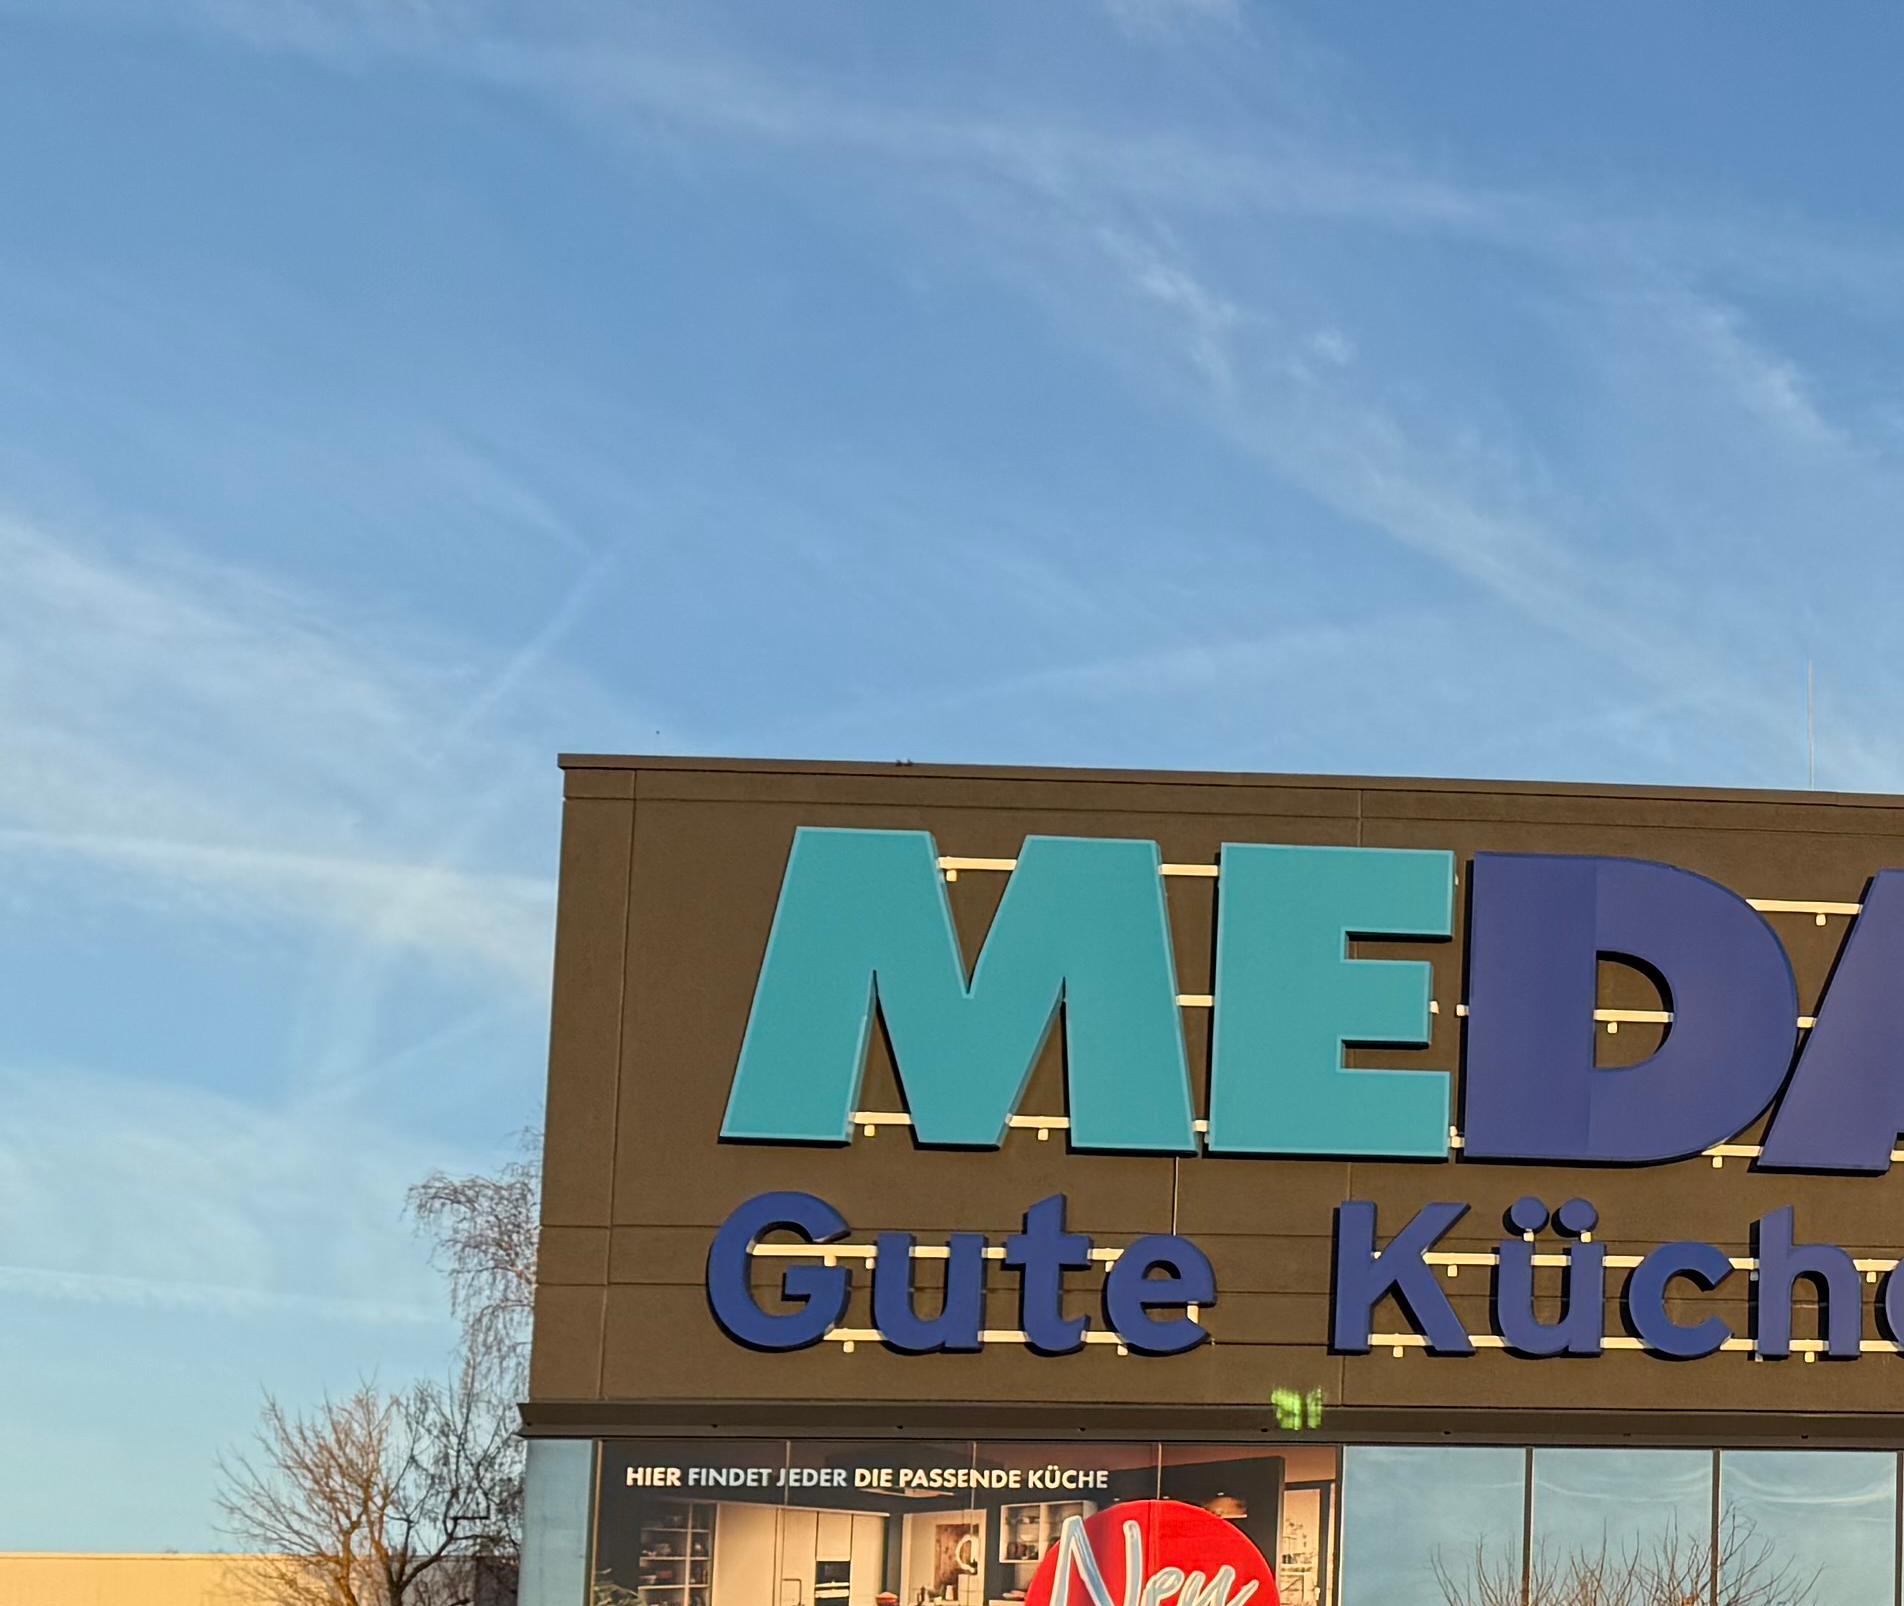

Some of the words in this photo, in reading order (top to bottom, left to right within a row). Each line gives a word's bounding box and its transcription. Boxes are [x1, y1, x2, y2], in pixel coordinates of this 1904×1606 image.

[707, 1191, 1217, 1355] Gute
[625, 1466, 682, 1488] HIER
[687, 1466, 771, 1488] FINDET
[776, 1466, 848, 1488] JEDER
[853, 1467, 894, 1489] DIE
[898, 1467, 1020, 1490] PASSENDE
[1027, 1464, 1109, 1490] KÜCHE
